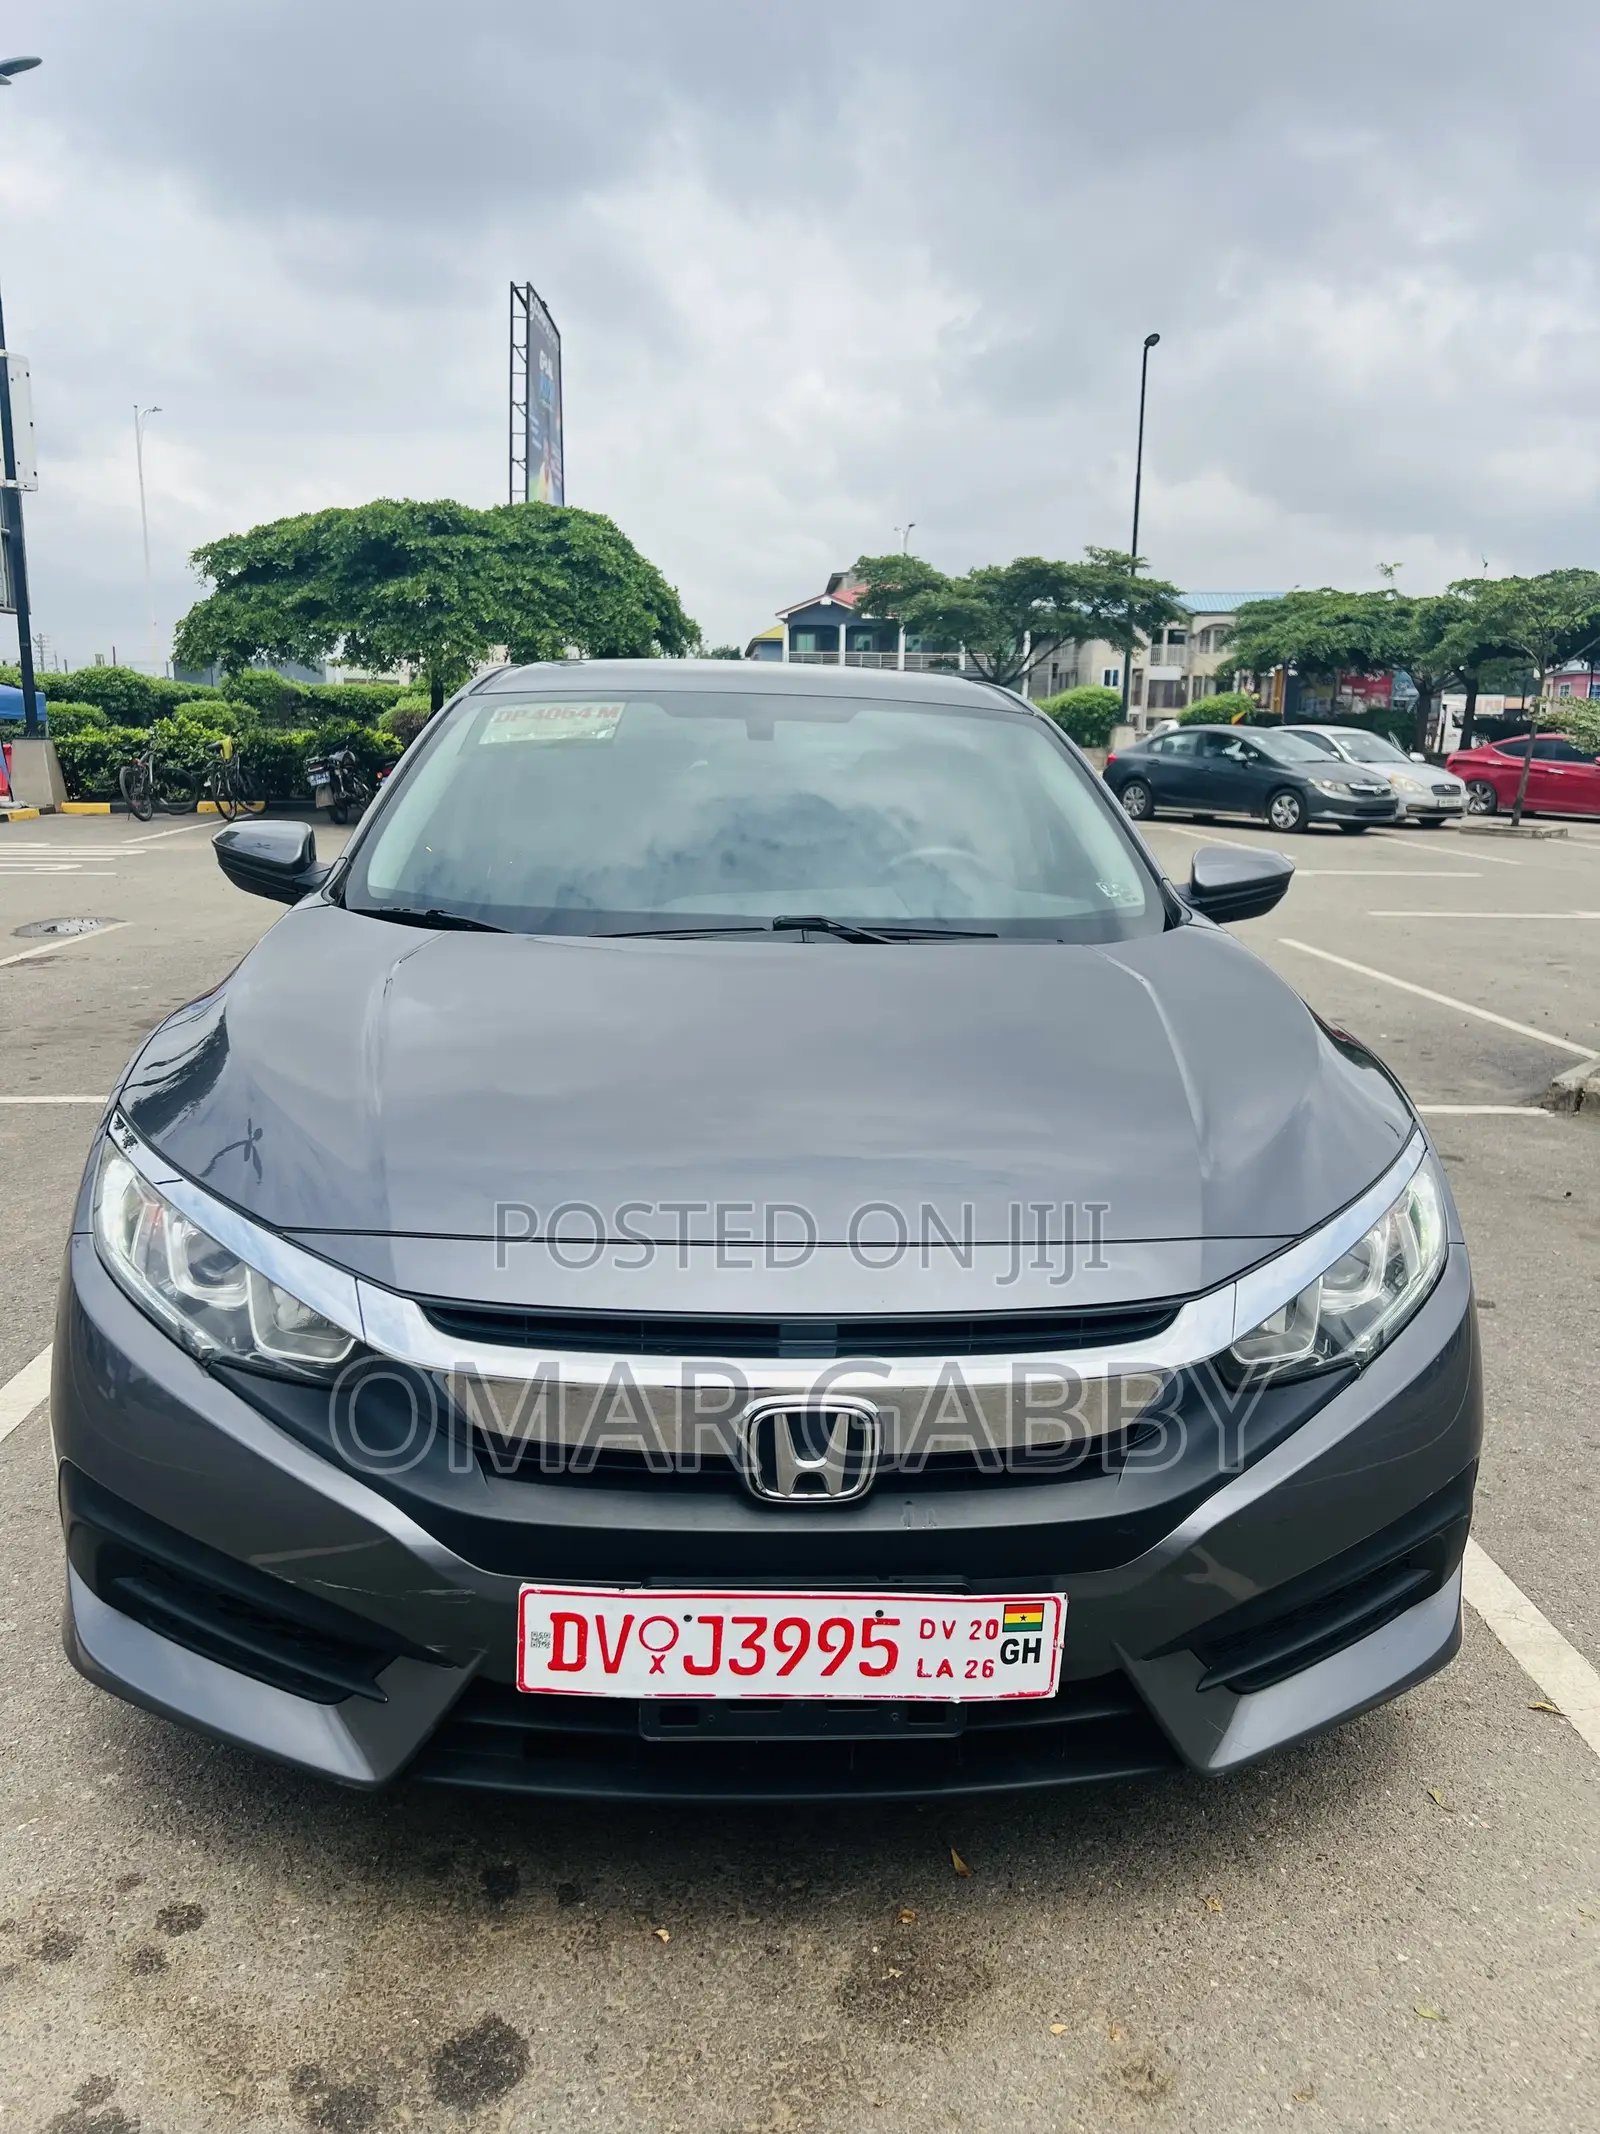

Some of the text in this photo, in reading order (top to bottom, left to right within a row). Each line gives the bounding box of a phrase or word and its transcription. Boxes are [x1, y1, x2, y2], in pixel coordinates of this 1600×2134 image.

[920, 1618, 999, 1640] DV 20
[547, 1612, 900, 1677] DV J3995
[1000, 1637, 1042, 1665] GH
[916, 1657, 995, 1679] LA 26
